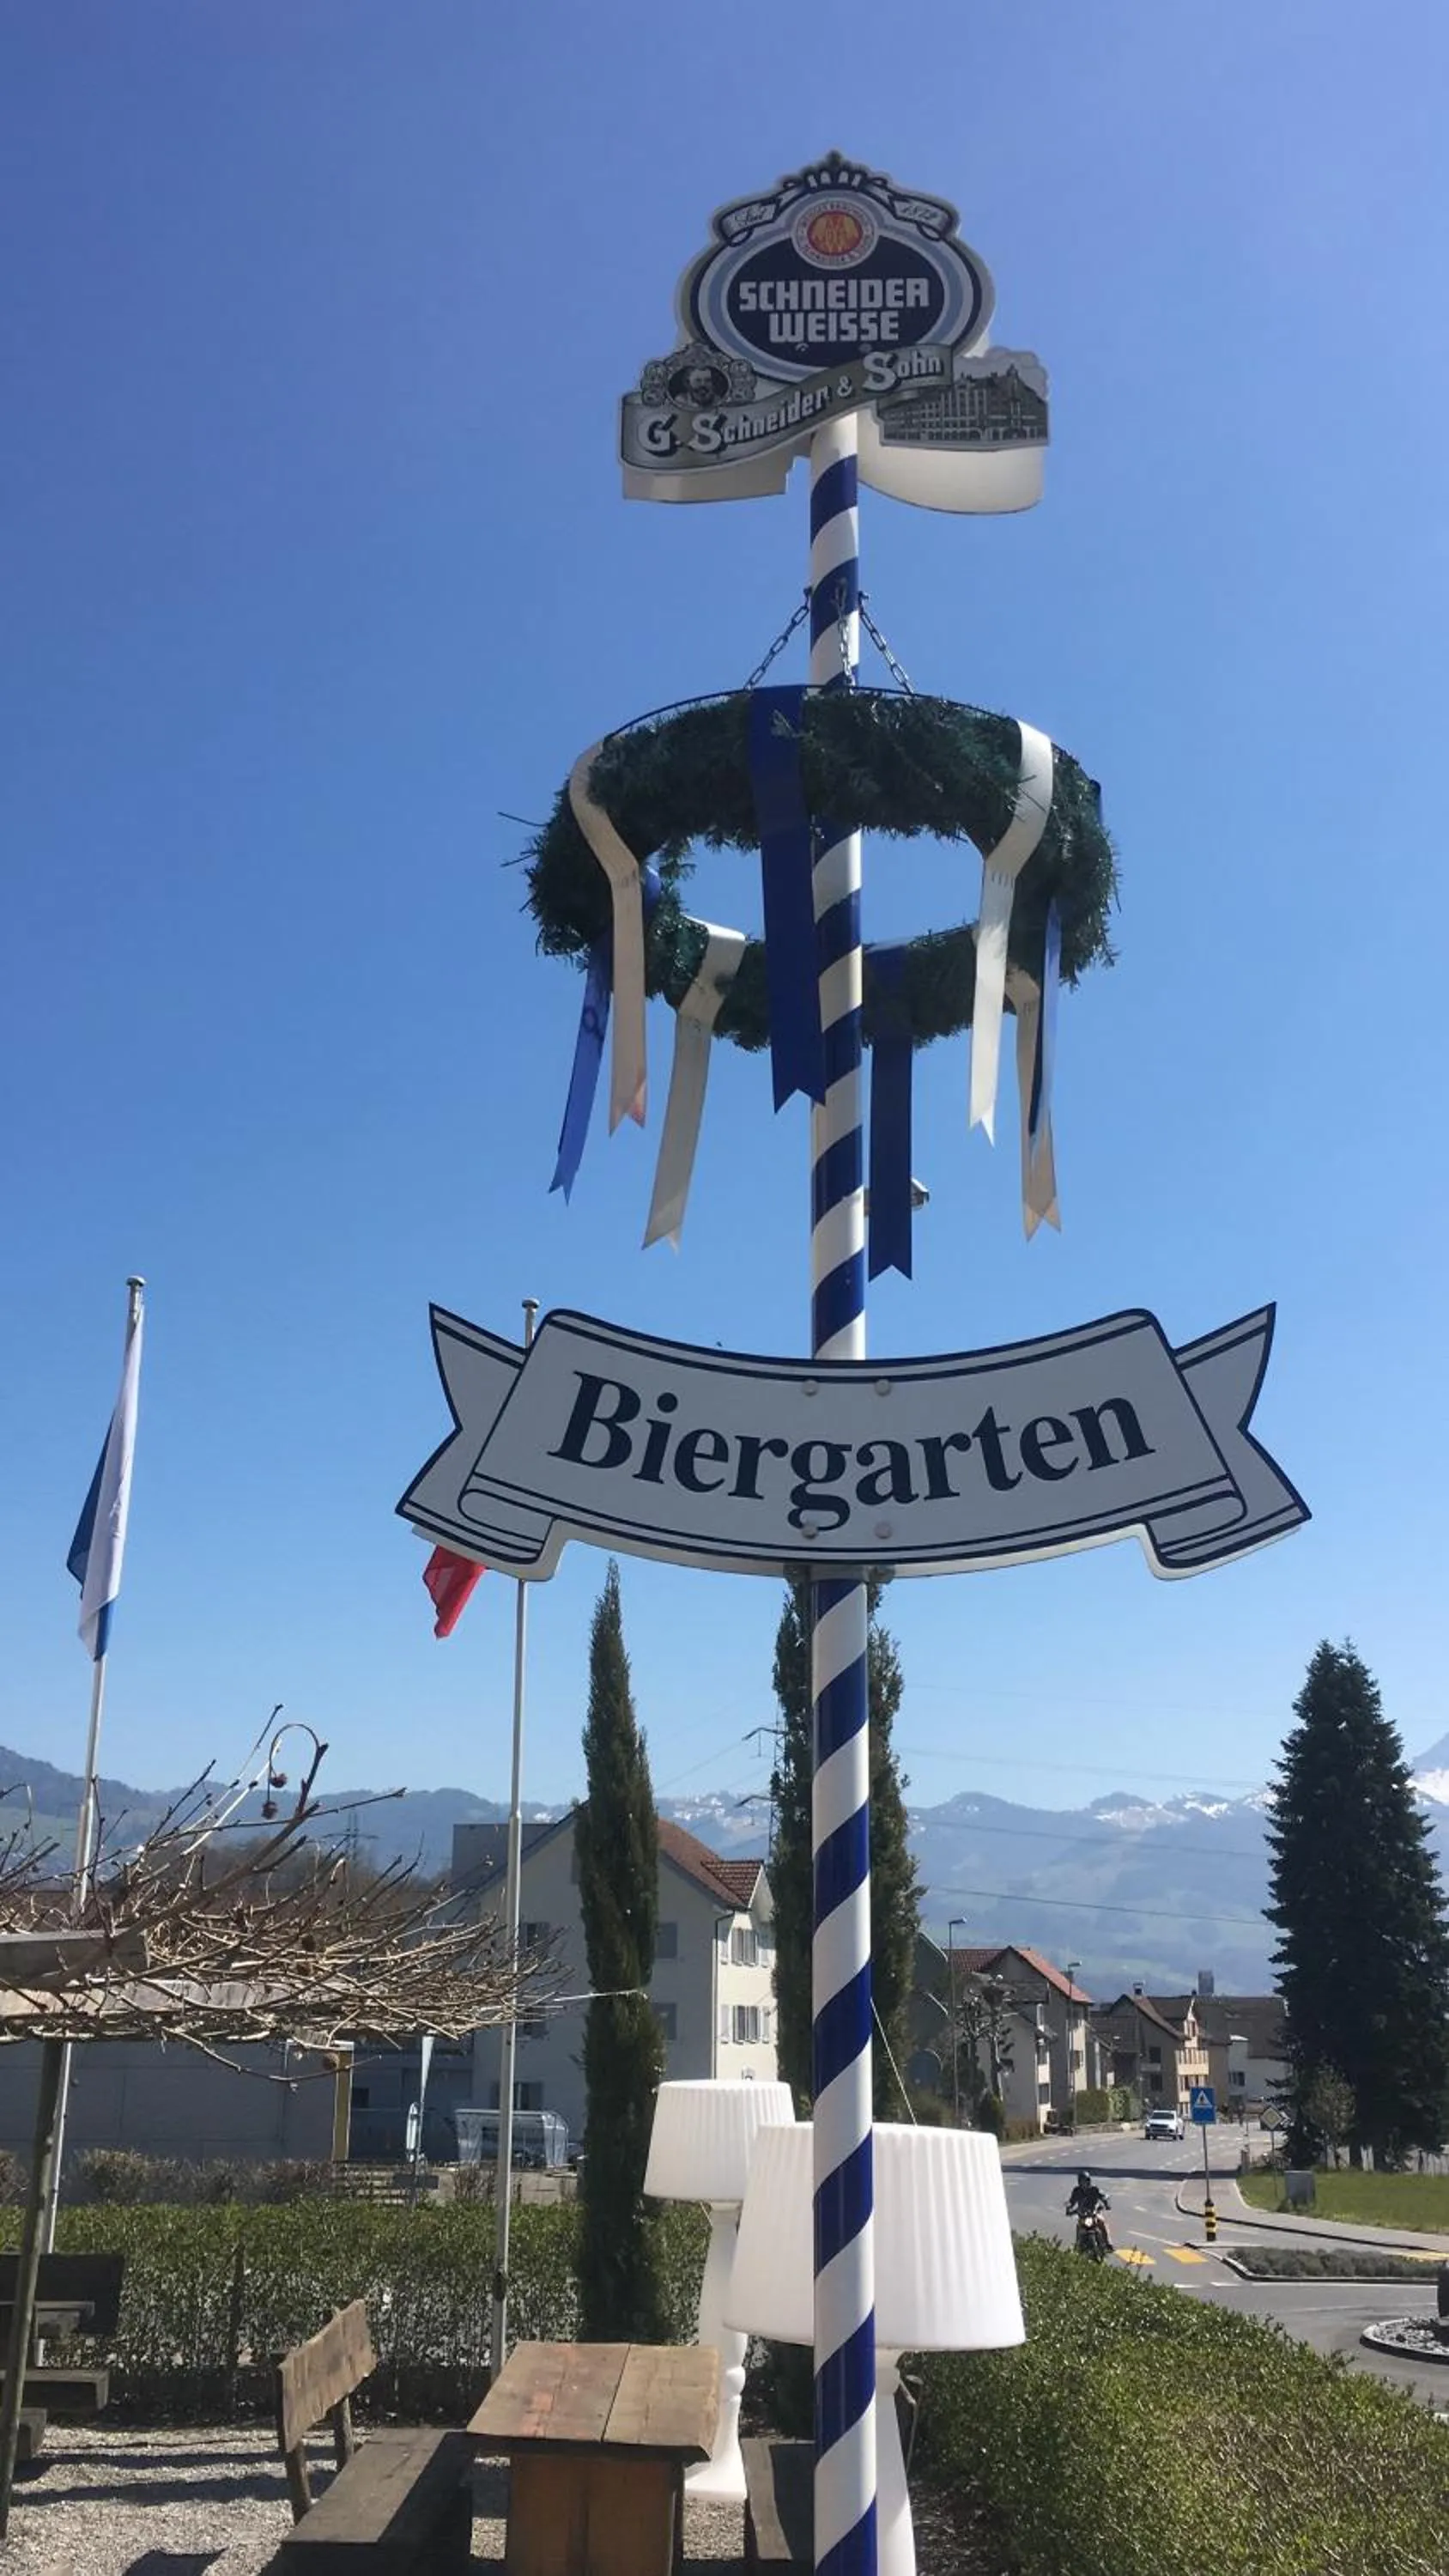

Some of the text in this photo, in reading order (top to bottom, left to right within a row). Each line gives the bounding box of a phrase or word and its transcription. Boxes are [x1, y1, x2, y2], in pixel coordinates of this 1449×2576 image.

[739, 277, 930, 312] SCHNEIDER
[769, 310, 899, 343] WEISSE
[688, 385, 831, 453] Schneider
[836, 376, 853, 398] &
[861, 350, 942, 391] Sohn
[548, 1370, 1156, 1532] Biergarten
